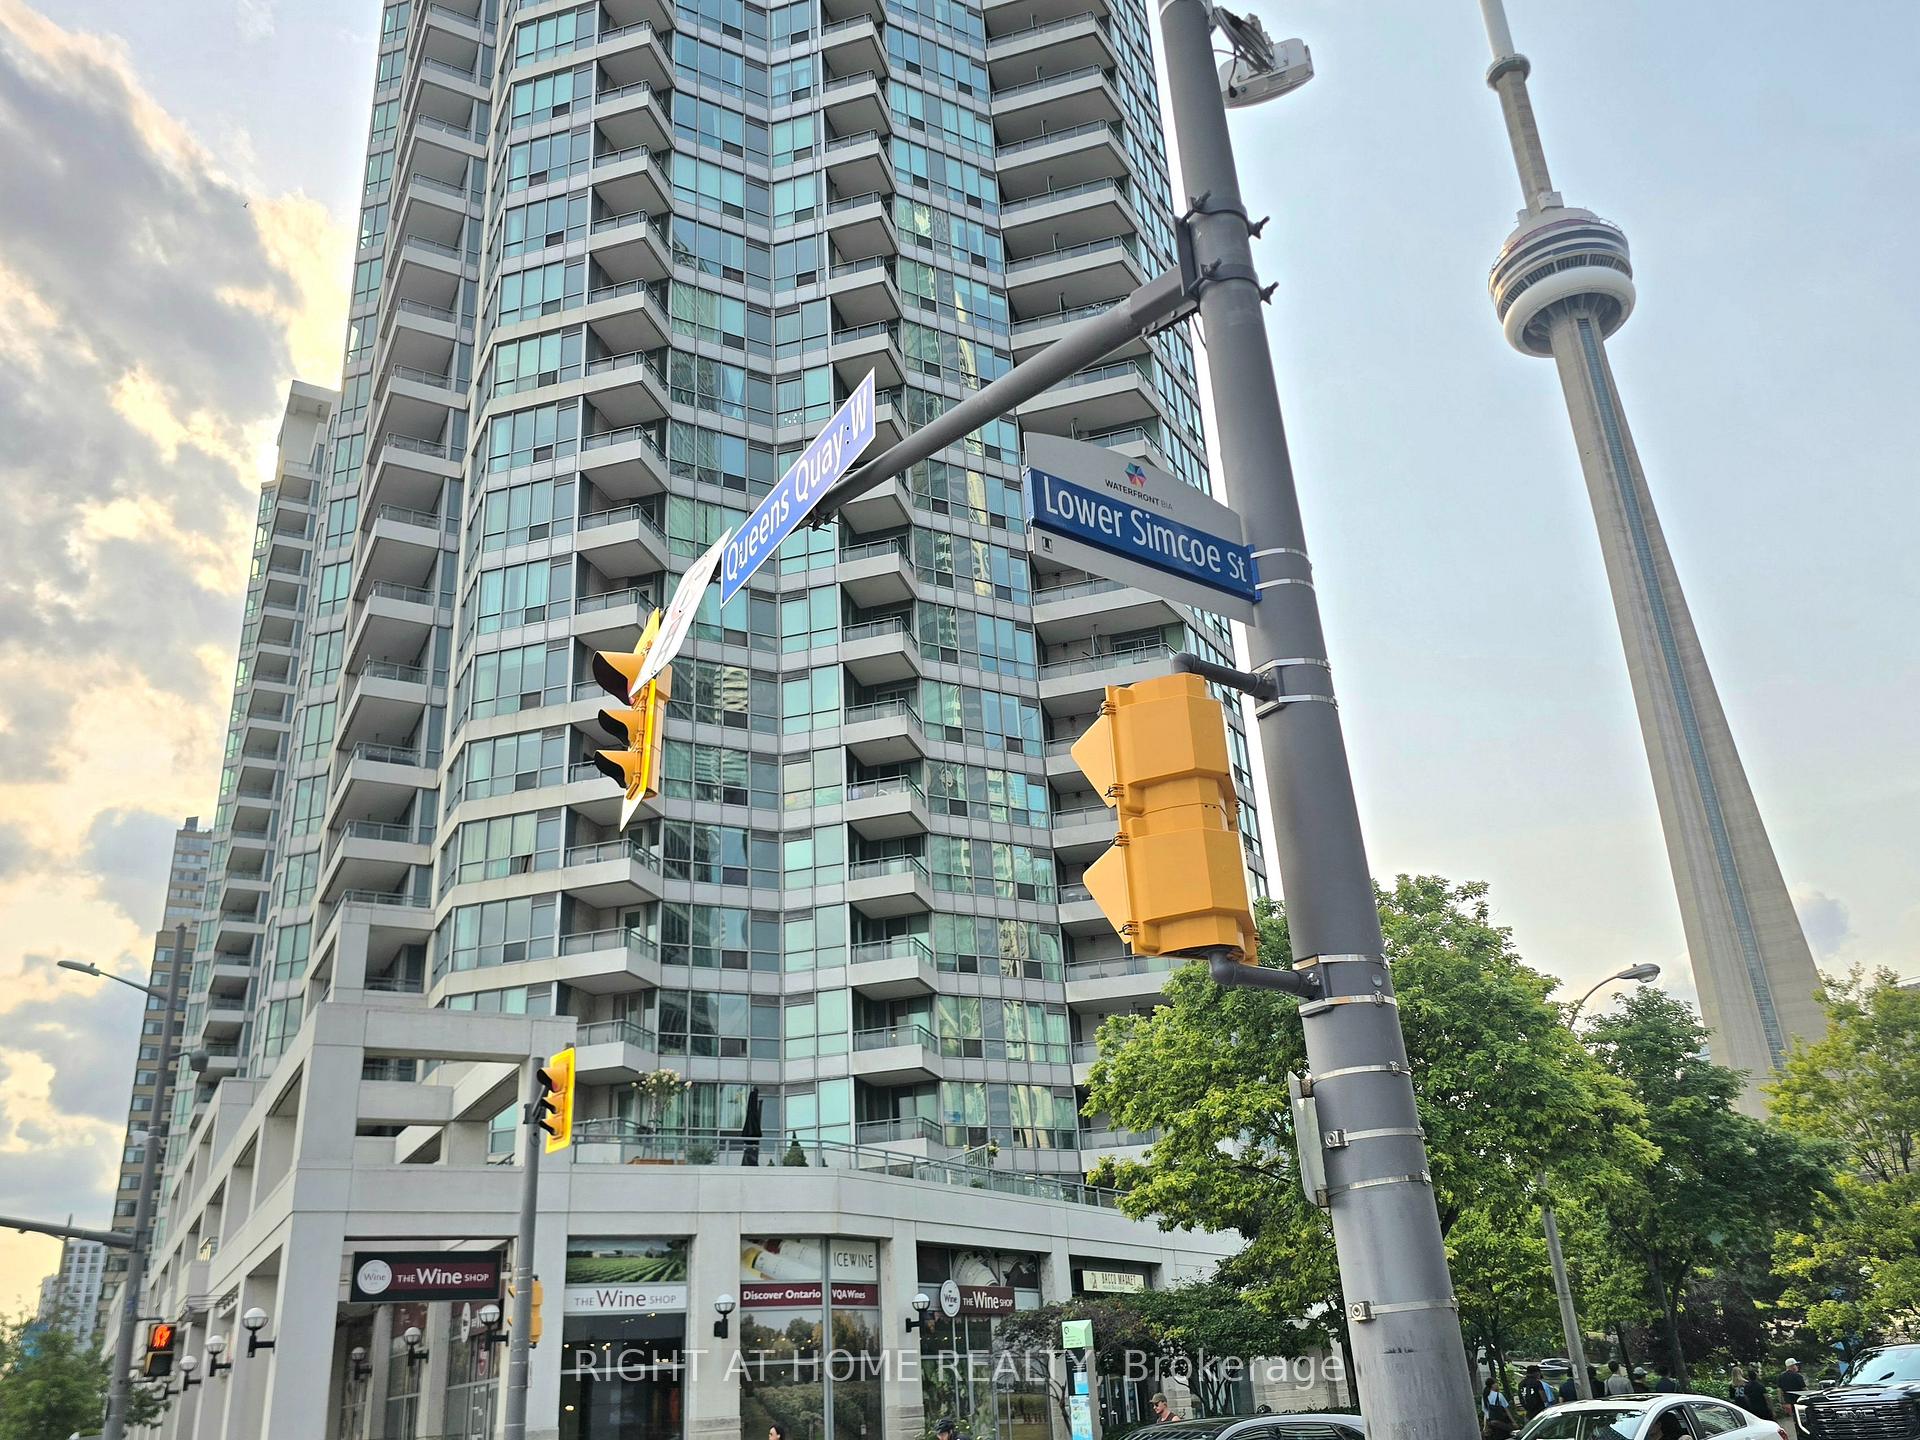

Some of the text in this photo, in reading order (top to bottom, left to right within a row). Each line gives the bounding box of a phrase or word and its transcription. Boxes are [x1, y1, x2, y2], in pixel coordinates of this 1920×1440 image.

[727, 386, 868, 581] Queens Quay W
[1105, 479, 1160, 506] WATERFRONT
[1043, 475, 1247, 583] Lower Simcoe St
[834, 1252, 874, 1269] ICEWINE
[397, 1268, 490, 1285] THE Wine SHOP
[575, 1289, 676, 1308] THE Wine SHOP
[743, 1290, 783, 1301] Discover
[785, 1289, 821, 1299] Ontario
[832, 1289, 846, 1299] VQA
[962, 1291, 1014, 1309] THE Wine SHOP
